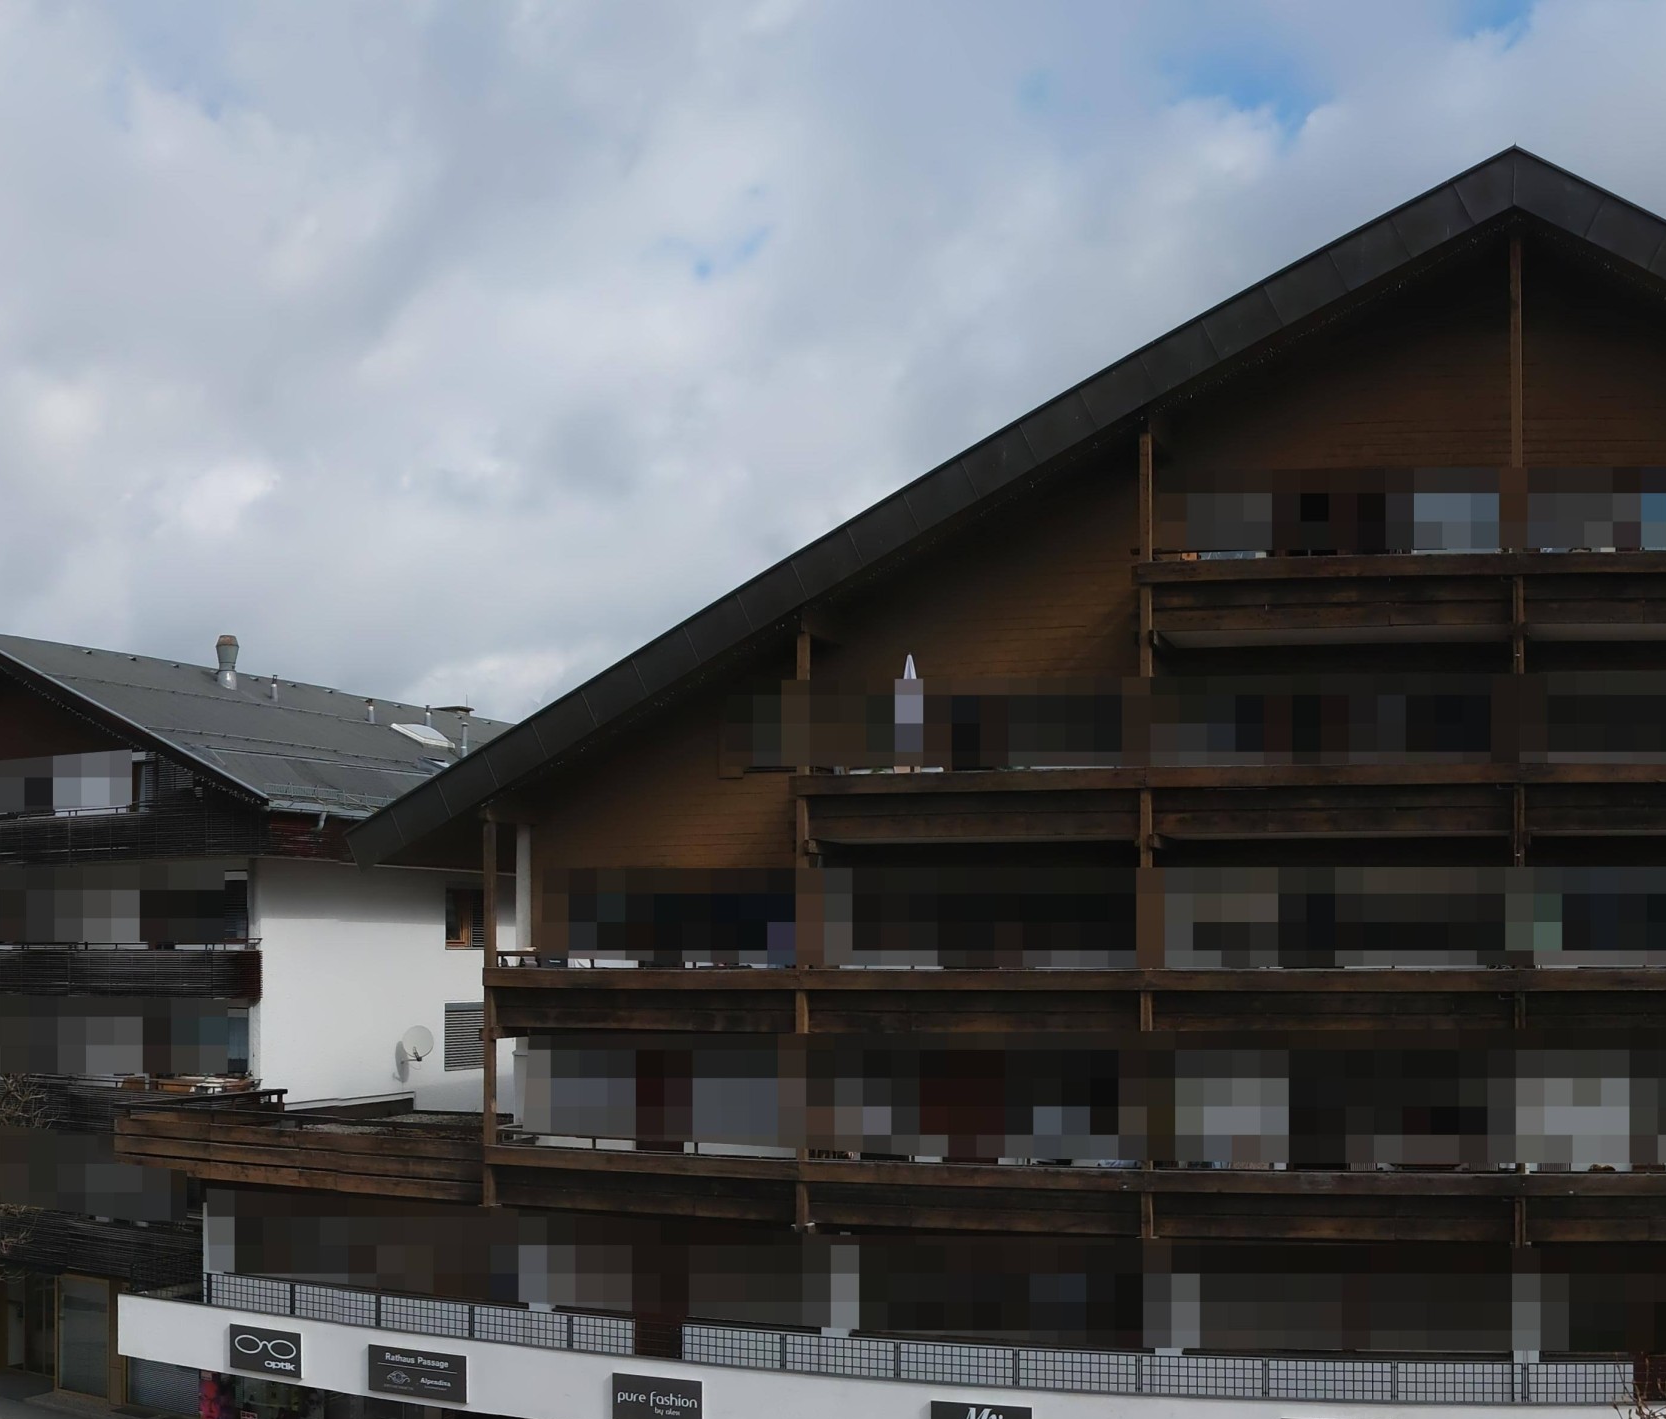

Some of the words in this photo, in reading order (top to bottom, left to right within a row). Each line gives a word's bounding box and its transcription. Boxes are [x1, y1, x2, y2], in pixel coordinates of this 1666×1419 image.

[264, 1360, 296, 1372] optik
[385, 1352, 415, 1365] Rathaus
[417, 1356, 449, 1369] Passage
[617, 1391, 646, 1404] pure
[650, 1391, 697, 1409] fashion
[655, 1407, 664, 1416] by
